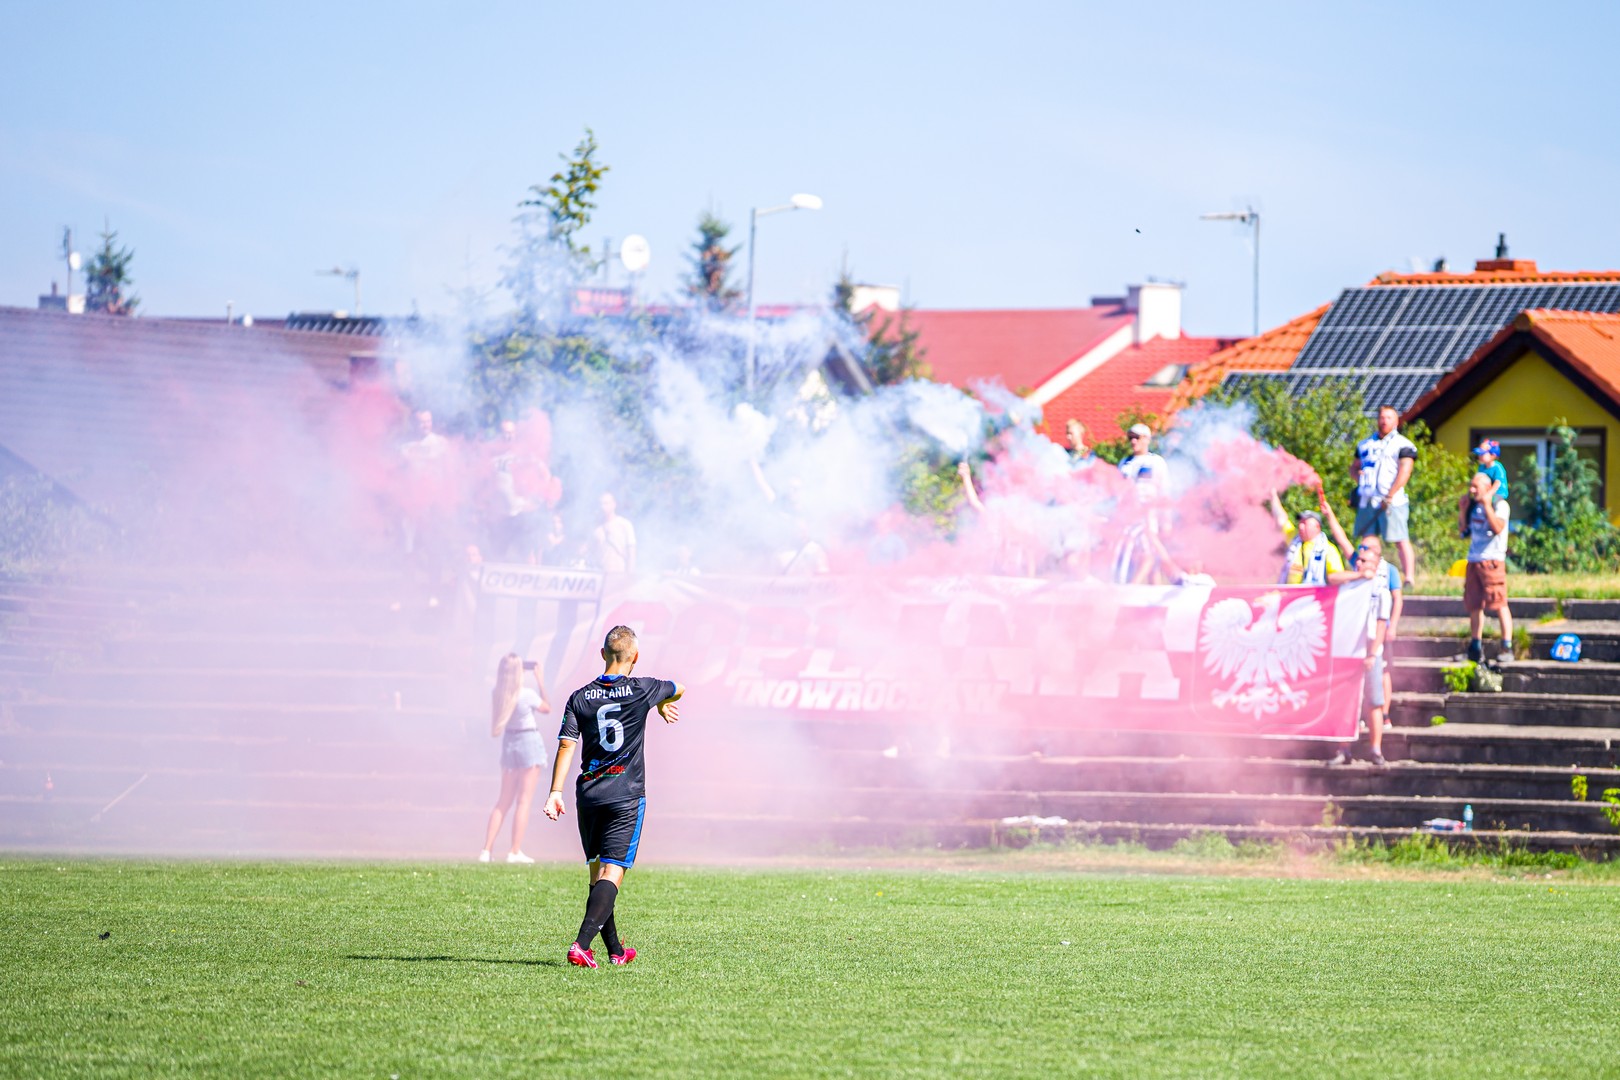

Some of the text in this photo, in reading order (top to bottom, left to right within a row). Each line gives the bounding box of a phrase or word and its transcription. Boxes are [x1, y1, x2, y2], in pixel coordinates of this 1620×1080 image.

[486, 571, 597, 592] GOPLANIA
[584, 685, 634, 700] GOPLANIA
[597, 703, 624, 752] 6
